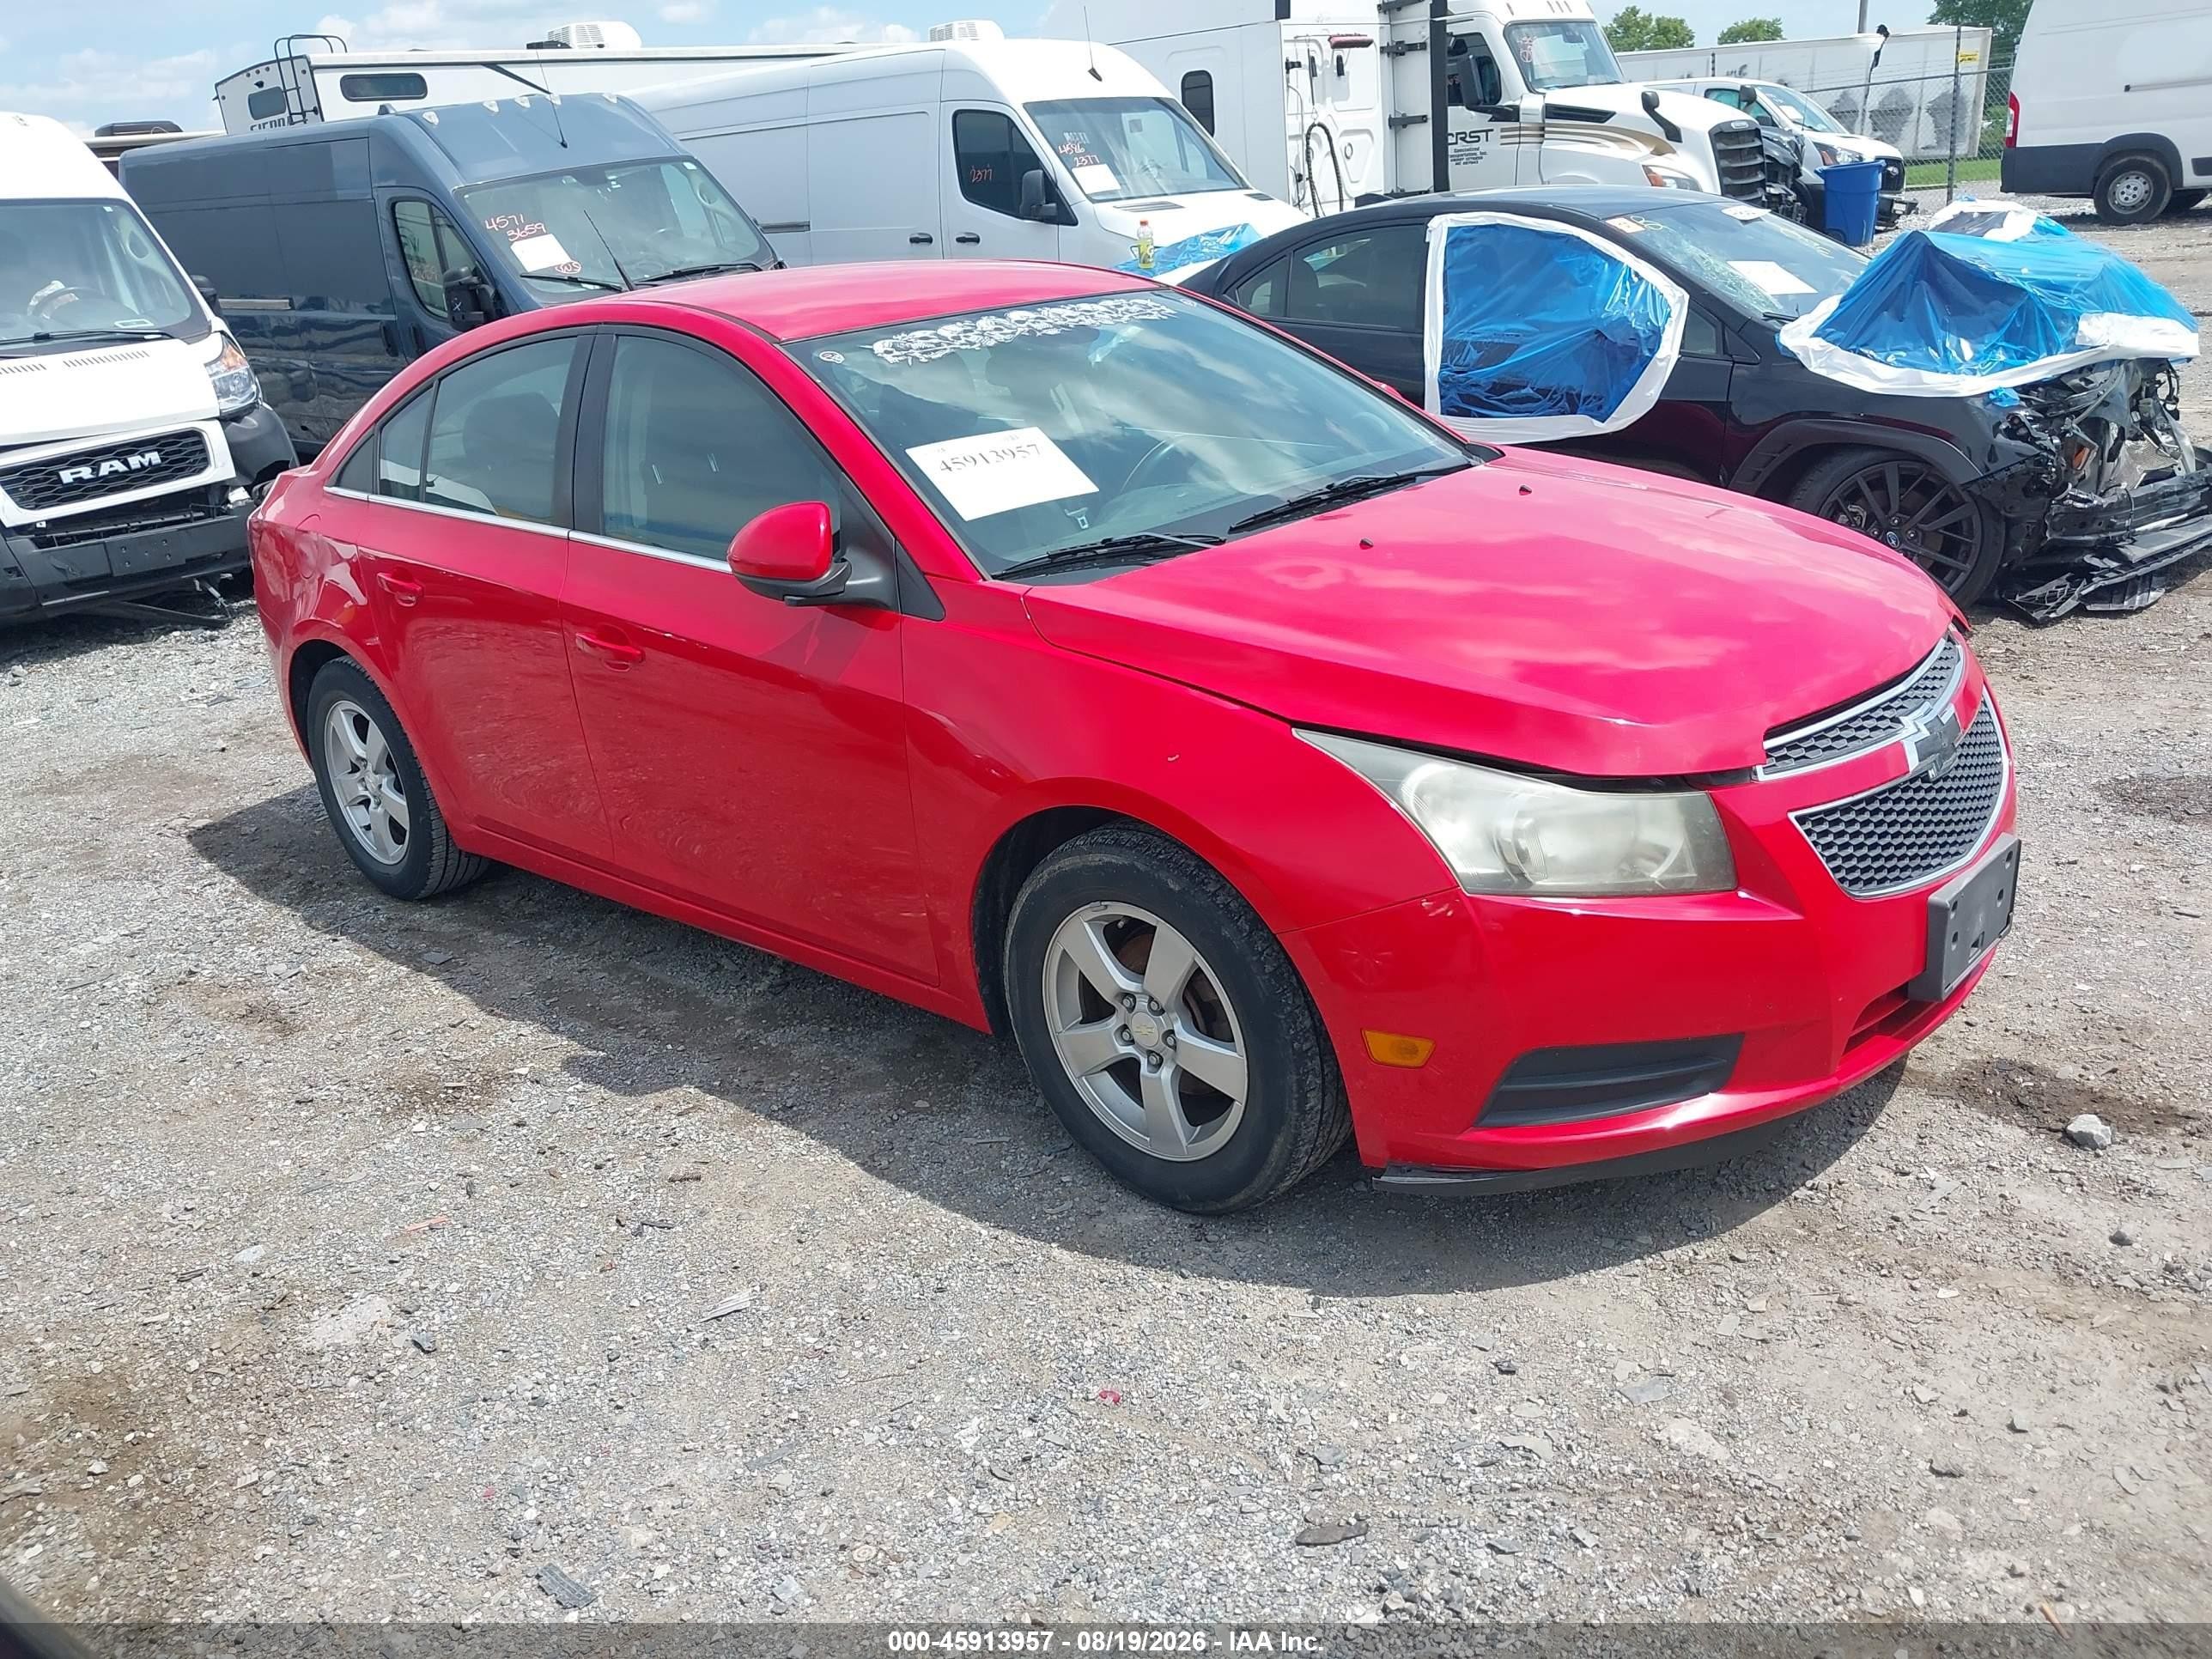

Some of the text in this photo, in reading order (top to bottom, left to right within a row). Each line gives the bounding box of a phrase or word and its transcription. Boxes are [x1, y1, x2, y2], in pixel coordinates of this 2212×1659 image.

[1448, 129, 1494, 145] CRST
[484, 213, 525, 232] 4571
[506, 222, 547, 242] 3659
[58, 451, 162, 484] RAM
[939, 444, 1041, 472] 45913957
